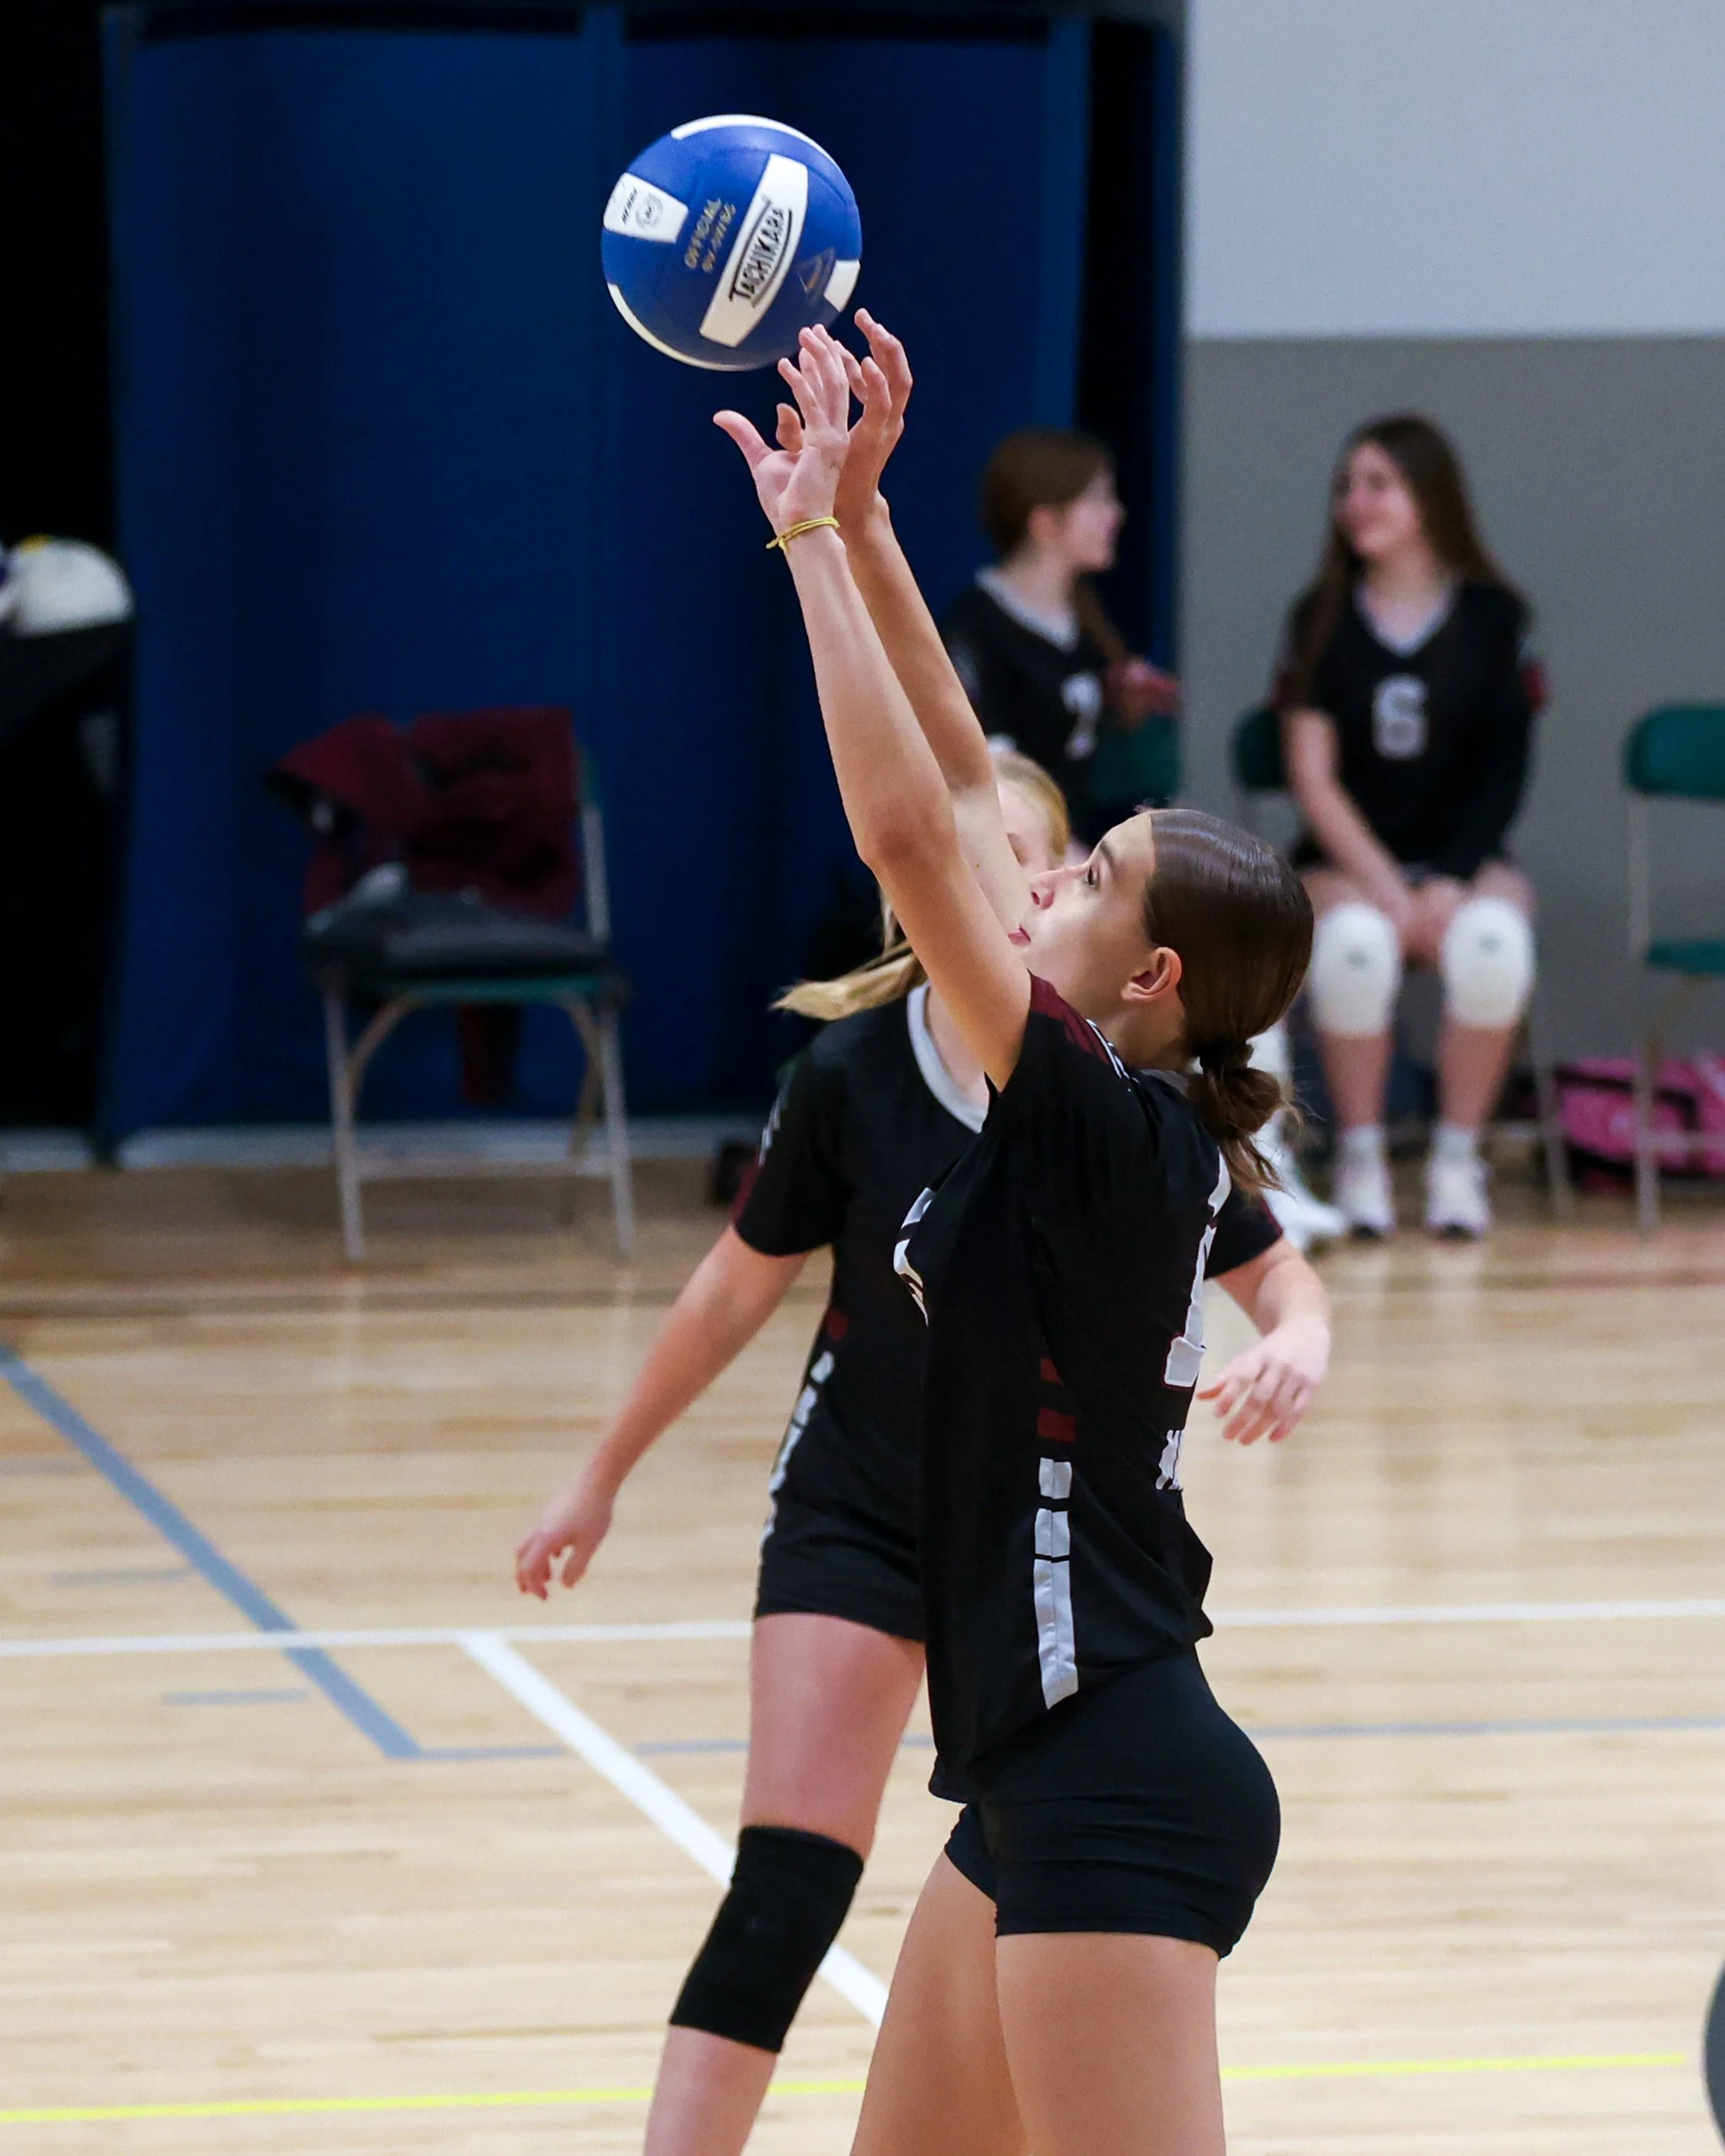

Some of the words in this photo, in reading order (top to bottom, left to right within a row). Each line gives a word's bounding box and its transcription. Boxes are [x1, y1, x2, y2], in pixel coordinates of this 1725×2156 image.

[684, 197, 722, 269] OFFICIAL
[728, 196, 787, 303] TACHIKARA
[1372, 673, 1428, 758] 6
